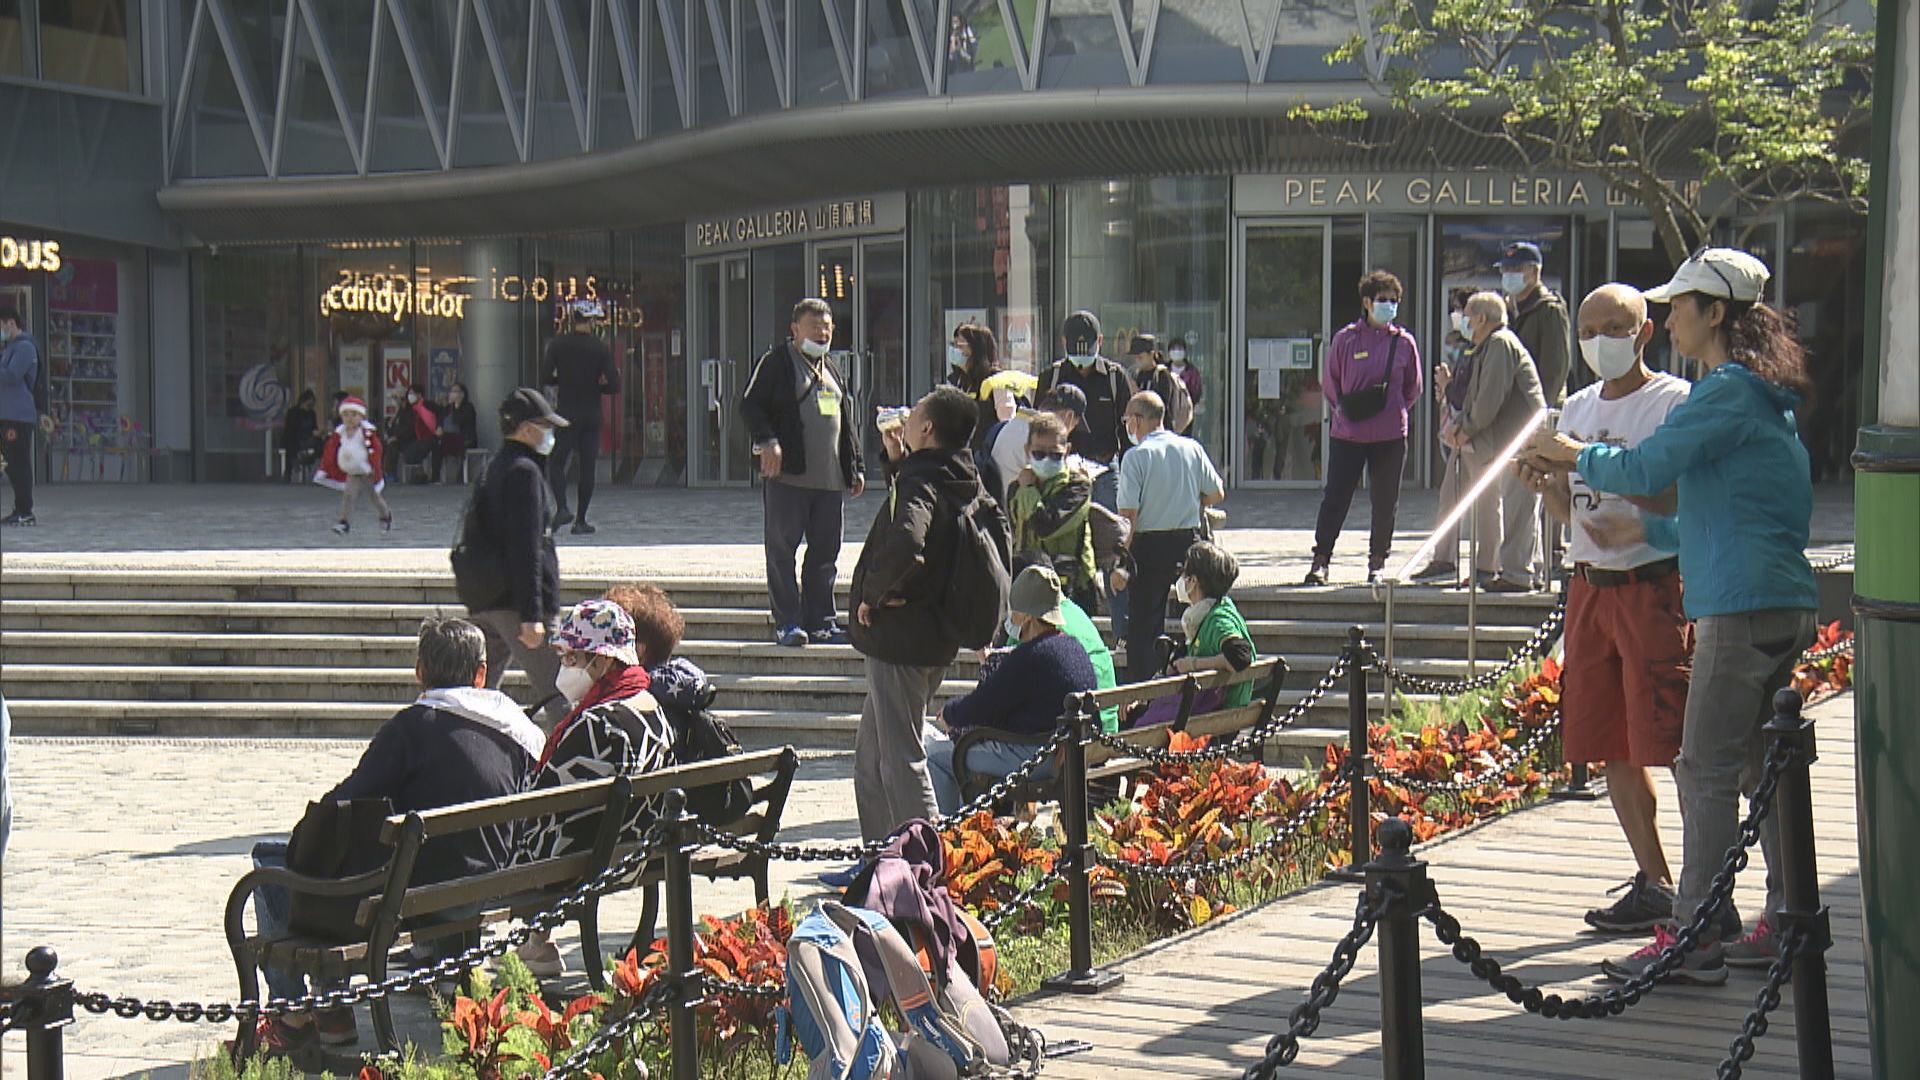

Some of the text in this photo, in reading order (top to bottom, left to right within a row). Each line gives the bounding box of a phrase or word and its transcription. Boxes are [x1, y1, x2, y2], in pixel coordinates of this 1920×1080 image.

[1285, 179, 1384, 206] PEAK
[1406, 177, 1590, 206] GALLERIA
[697, 219, 730, 246] PEAK
[736, 208, 808, 241] GALLERIA
